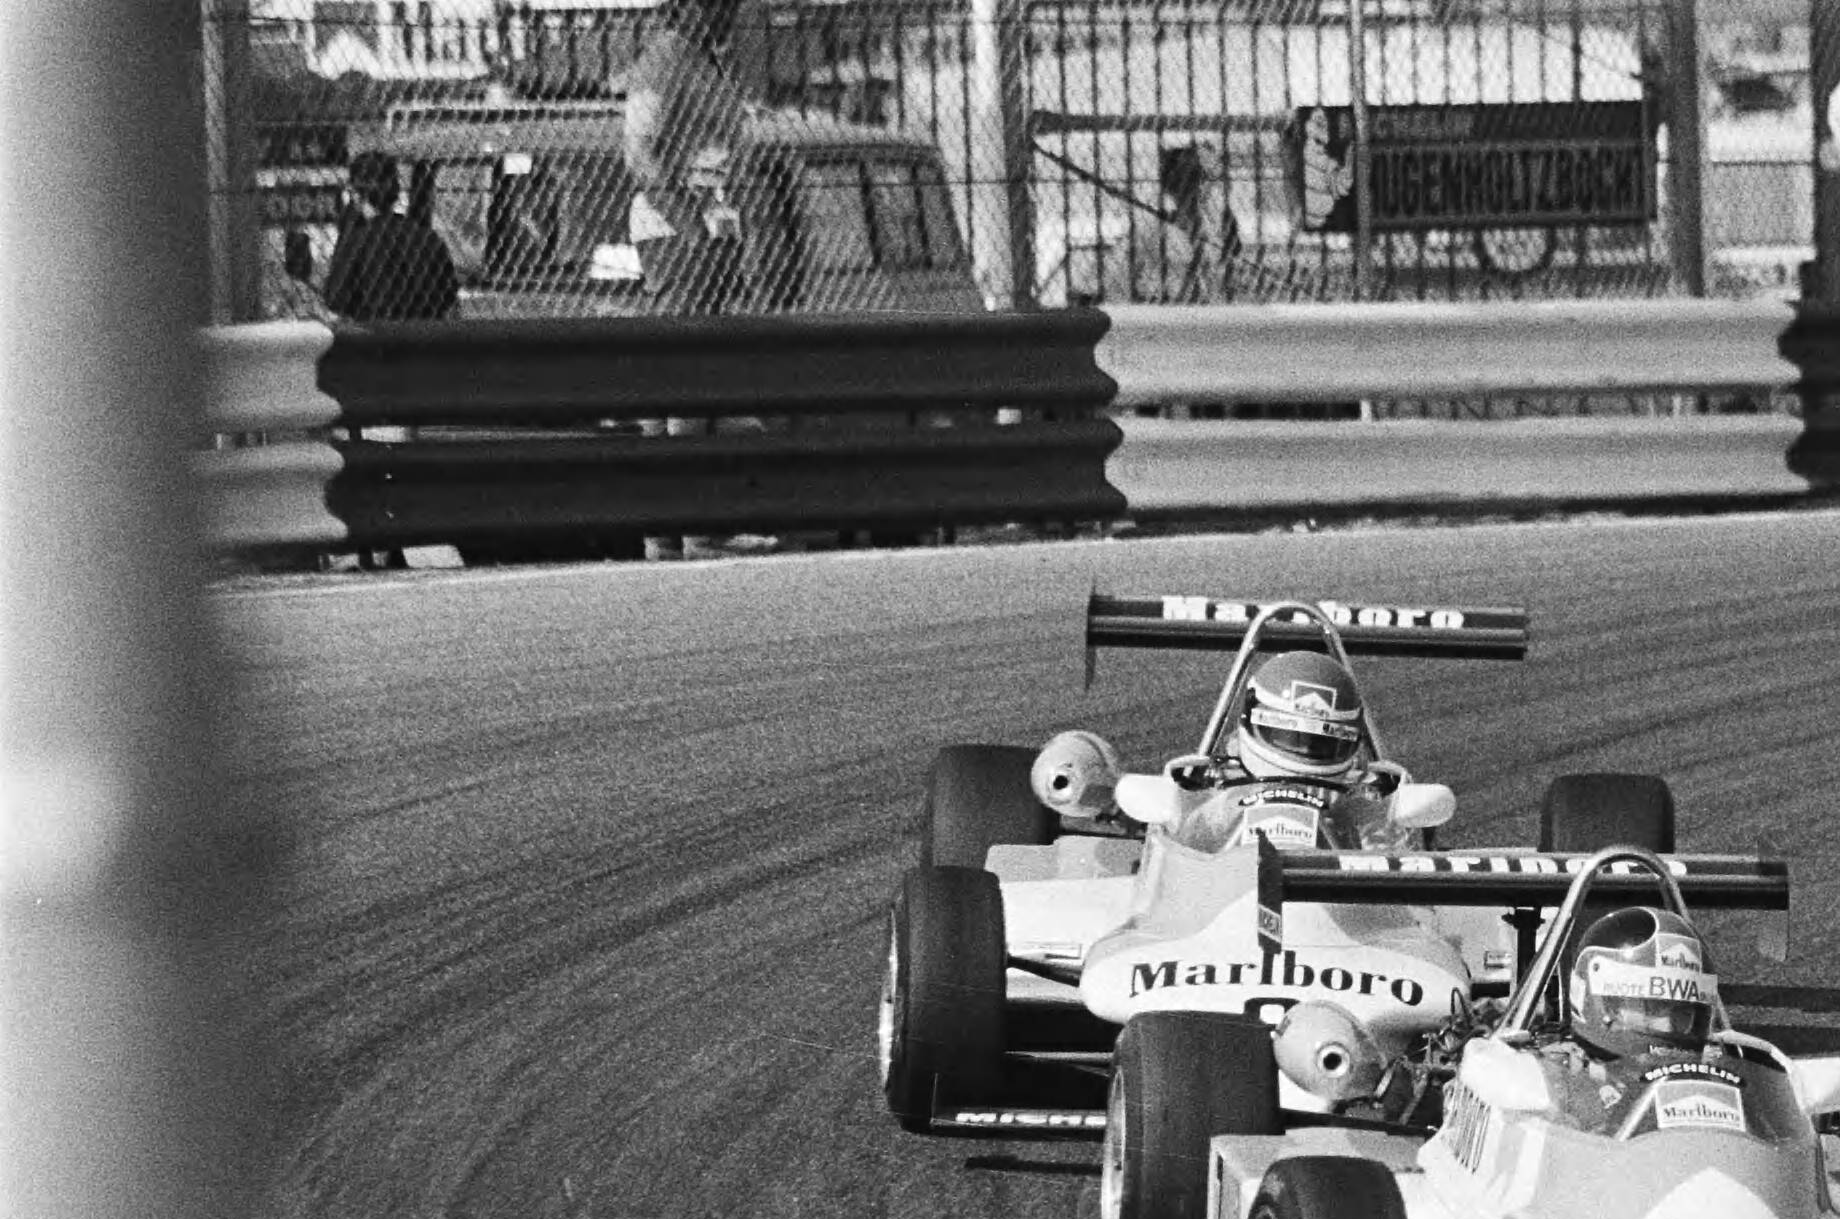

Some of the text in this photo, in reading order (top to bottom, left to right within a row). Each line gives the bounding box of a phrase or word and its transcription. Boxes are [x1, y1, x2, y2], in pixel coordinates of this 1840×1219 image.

[1338, 111, 1475, 138] MCHELIN
[1161, 595, 1465, 629] Maboro
[1242, 789, 1324, 808] MICHELIN
[1248, 823, 1313, 839] Mrlboro
[1128, 949, 1424, 1007] Marlboro
[1650, 976, 1700, 1001] BWA
[1644, 1063, 1741, 1084] MICHELIN
[1663, 1103, 1736, 1120] Marlboro
